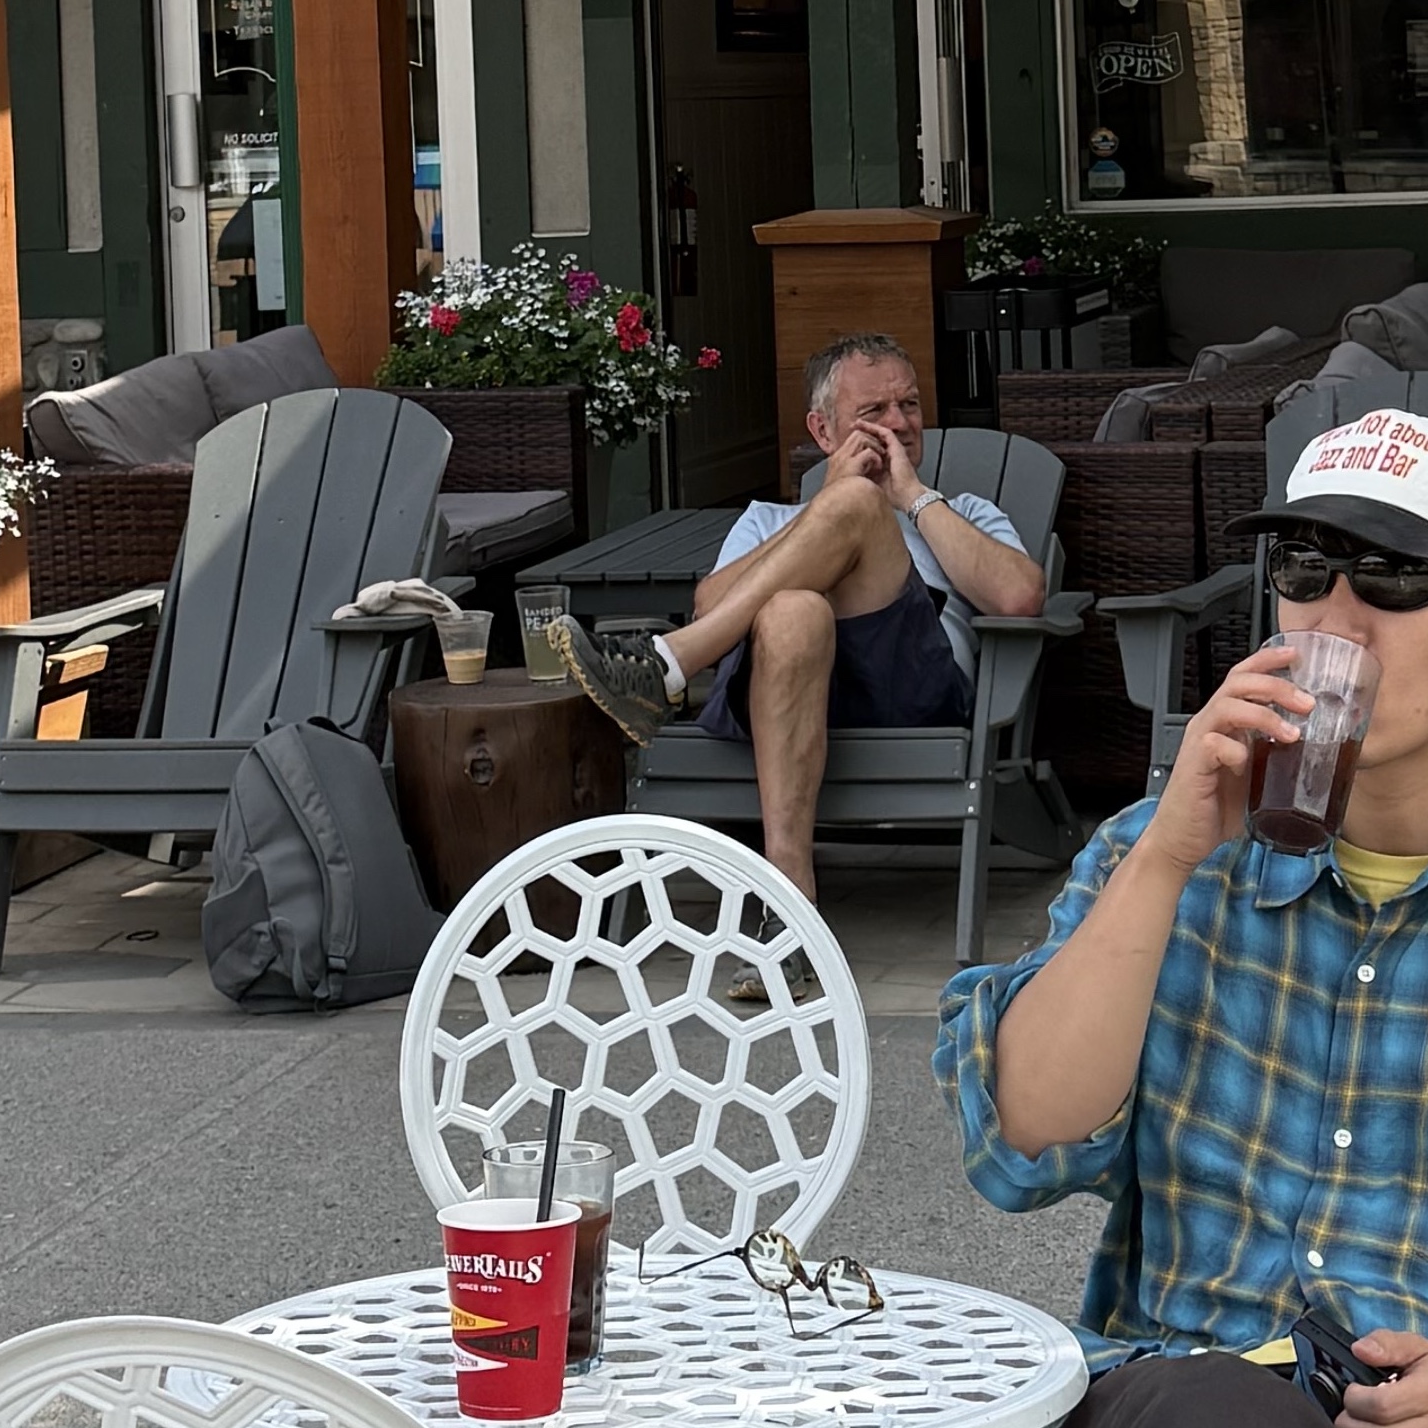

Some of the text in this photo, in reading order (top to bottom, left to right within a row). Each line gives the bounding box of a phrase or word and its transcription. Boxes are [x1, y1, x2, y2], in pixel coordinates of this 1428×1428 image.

[1098, 54, 1175, 80] OPEN
[1341, 440, 1384, 470] and
[1378, 443, 1419, 478] Bar
